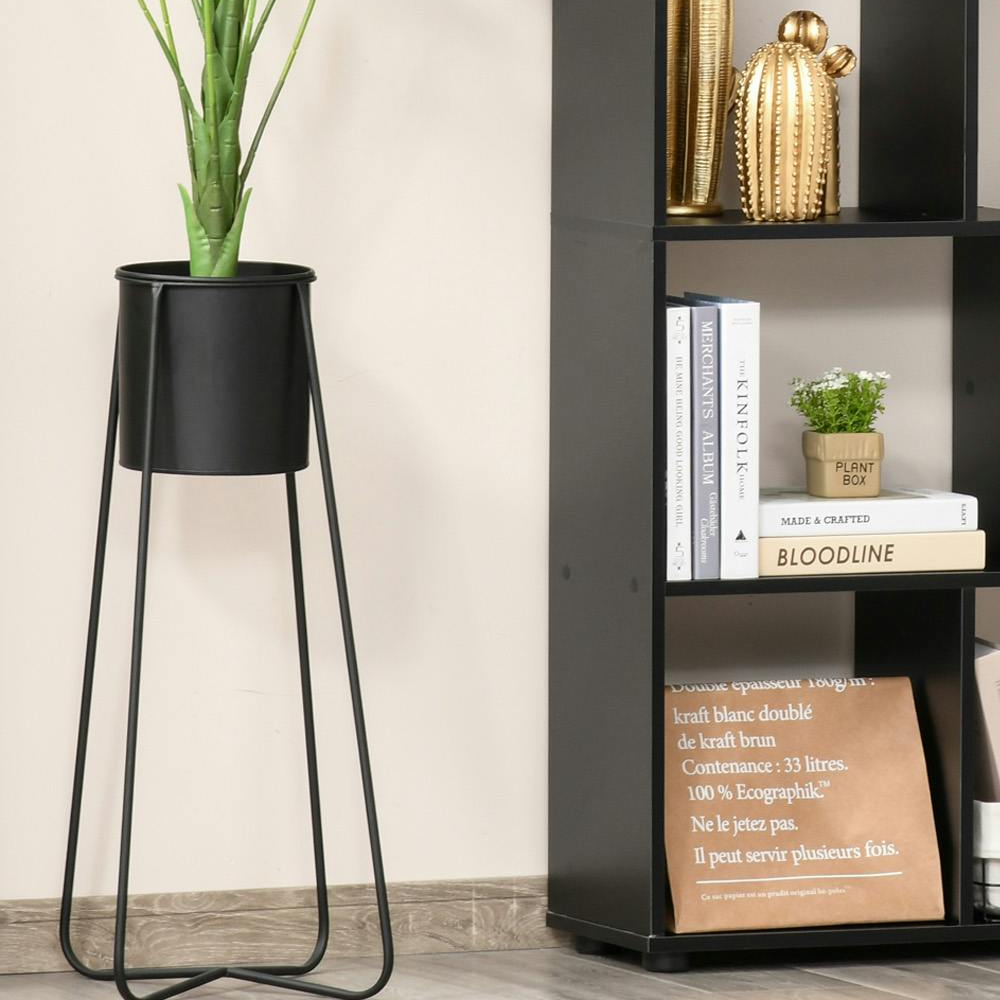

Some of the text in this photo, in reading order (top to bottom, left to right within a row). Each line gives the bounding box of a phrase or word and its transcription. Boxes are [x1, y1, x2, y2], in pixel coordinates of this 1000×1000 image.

[702, 321, 715, 485] MERCHANTS ALBUM
[736, 379, 749, 474] KINFOLK
[835, 462, 875, 473] PLANT
[843, 475, 866, 486] BOX
[781, 514, 870, 526] MADE & CRAFTED
[777, 544, 895, 567] BLOODLINE
[673, 703, 813, 724] kraft blanc doublé
[678, 731, 777, 750] de kraft brun
[681, 759, 773, 775] Contenance
[784, 757, 801, 773] 33
[805, 755, 849, 773] litres.
[687, 785, 715, 801] 100
[690, 814, 799, 837] Ne le jetez pas.
[694, 840, 900, 869] Il peut servir plusieurs fois.
